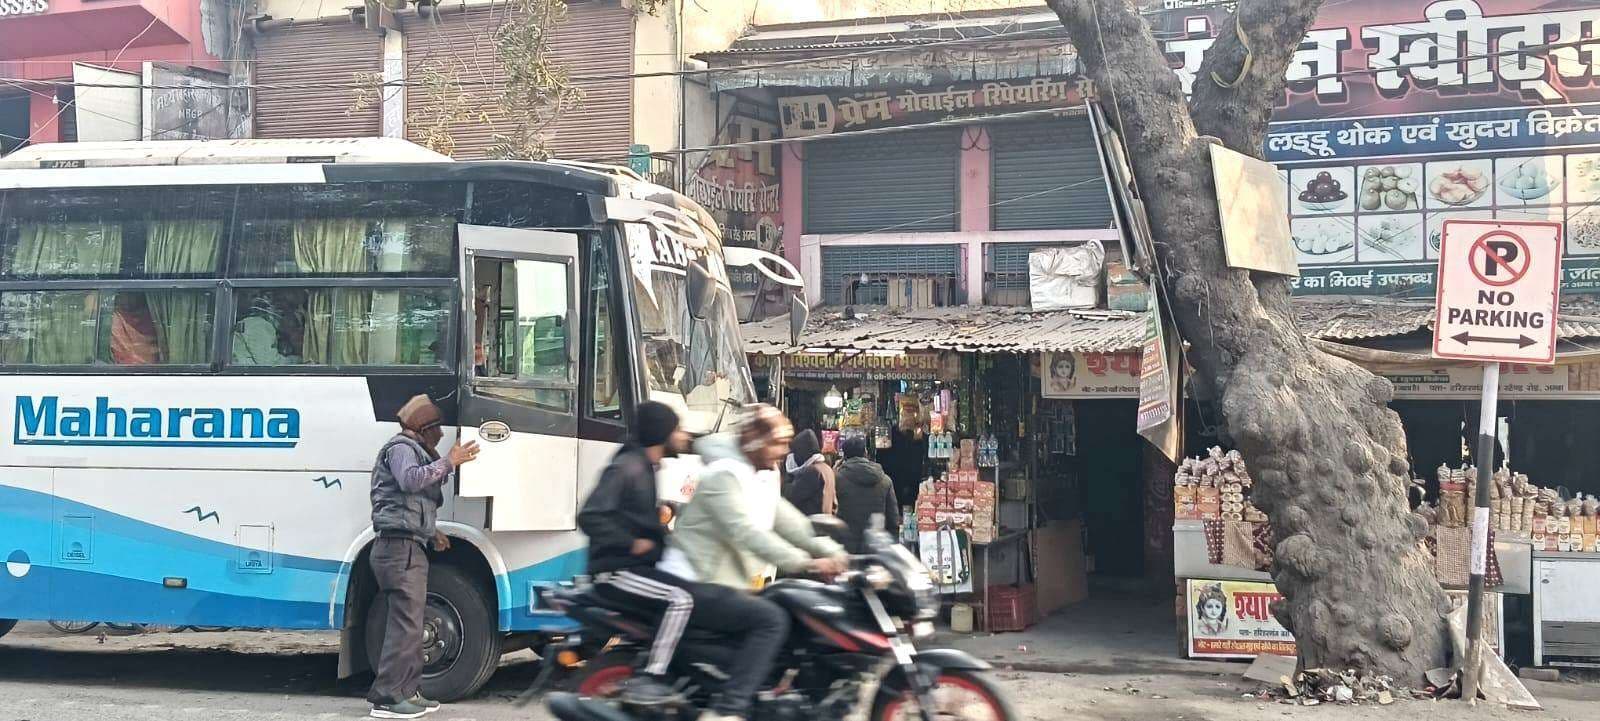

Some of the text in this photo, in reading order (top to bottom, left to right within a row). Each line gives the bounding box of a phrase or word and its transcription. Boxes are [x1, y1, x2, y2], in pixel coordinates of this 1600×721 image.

[1337, 121, 1394, 146] थोक
[1400, 117, 1440, 144] एवं
[1445, 119, 1521, 149] खुदरा
[1304, 275, 1325, 288] का
[1329, 269, 1374, 289] मिठाई
[1377, 272, 1433, 286] उपलब्ध
[1478, 290, 1515, 306] NO
[1448, 307, 1544, 329] PARKING
[14, 396, 300, 447] Maharana
